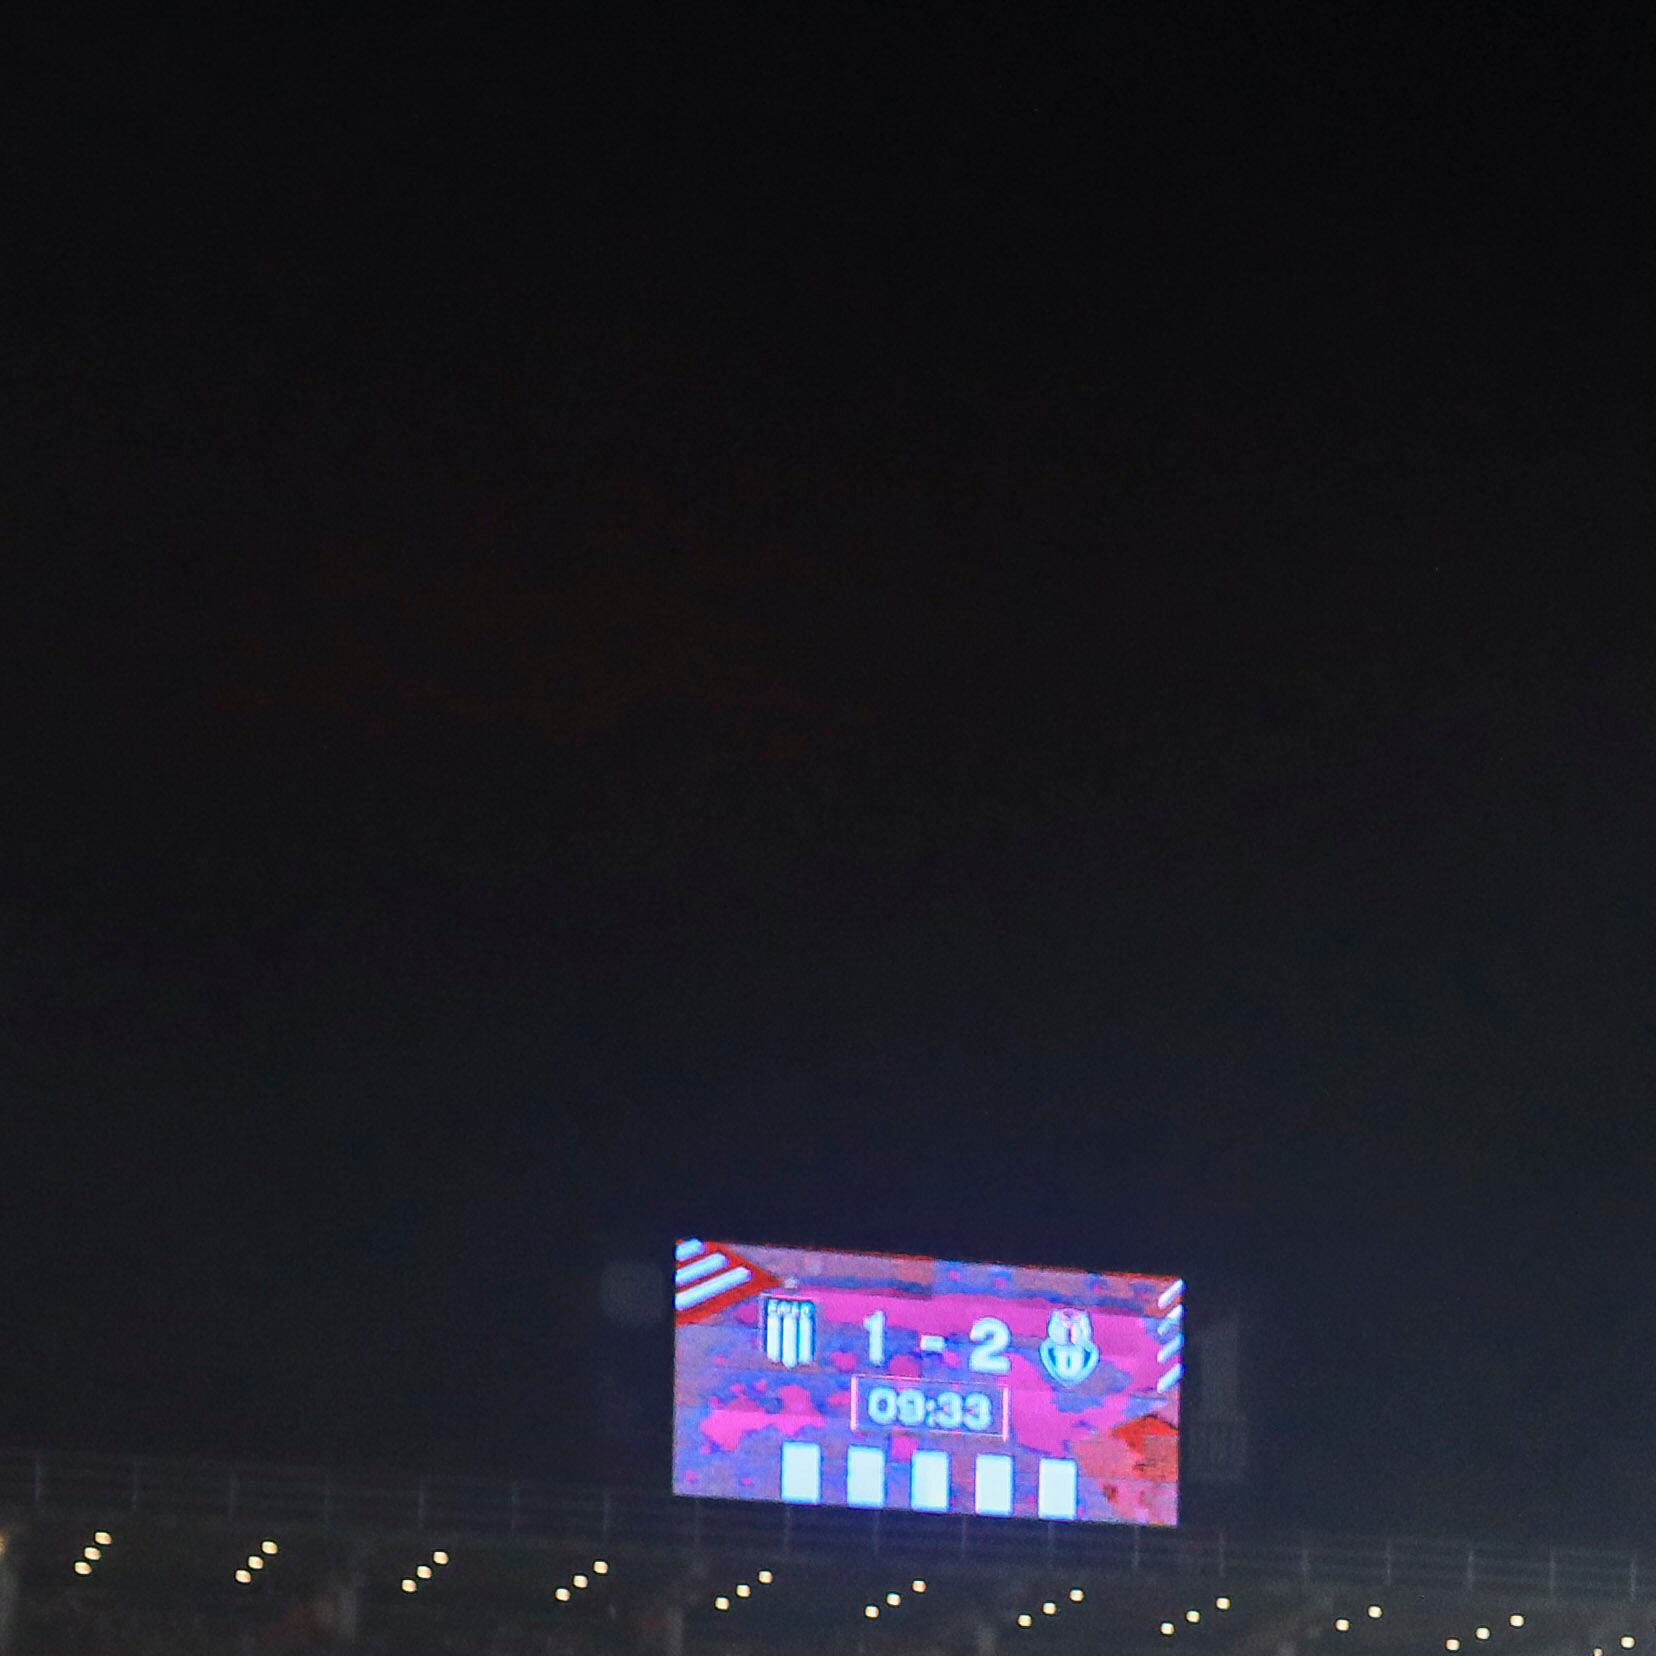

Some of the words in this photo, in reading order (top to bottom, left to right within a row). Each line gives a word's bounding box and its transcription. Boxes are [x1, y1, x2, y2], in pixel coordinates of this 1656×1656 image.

[863, 1310, 887, 1367] 1
[967, 1317, 1012, 1375] 2
[868, 1386, 993, 1431] 09:33
